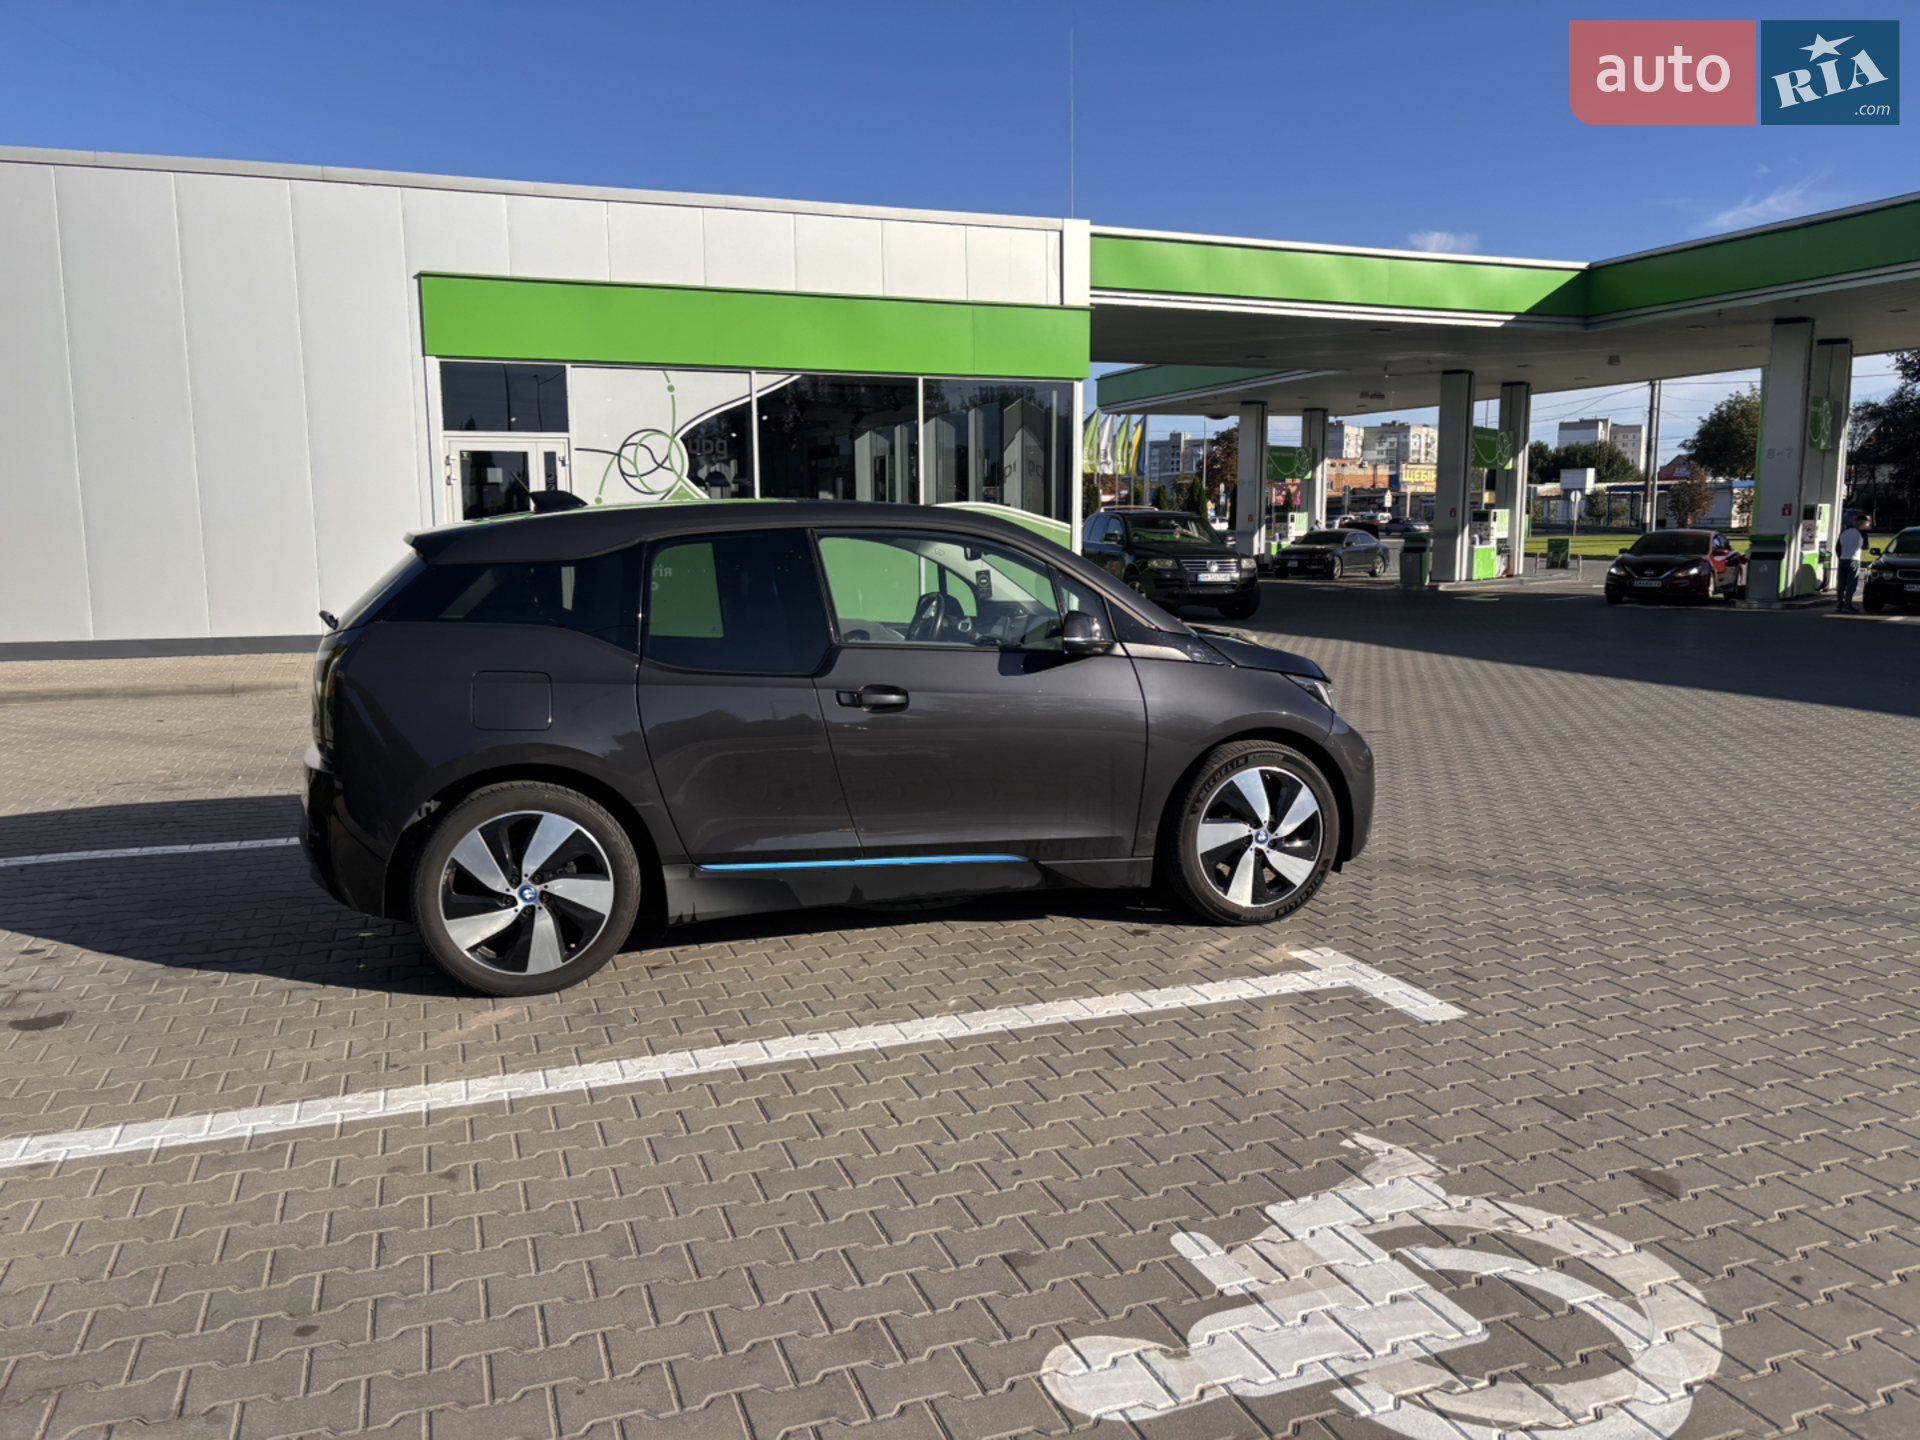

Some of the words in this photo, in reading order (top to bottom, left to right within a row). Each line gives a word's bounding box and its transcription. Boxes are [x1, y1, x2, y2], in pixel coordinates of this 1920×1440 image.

[688, 439, 728, 460] upg
[1198, 755, 1249, 802] MICHELIN
[1276, 871, 1325, 917] MICHELIN
